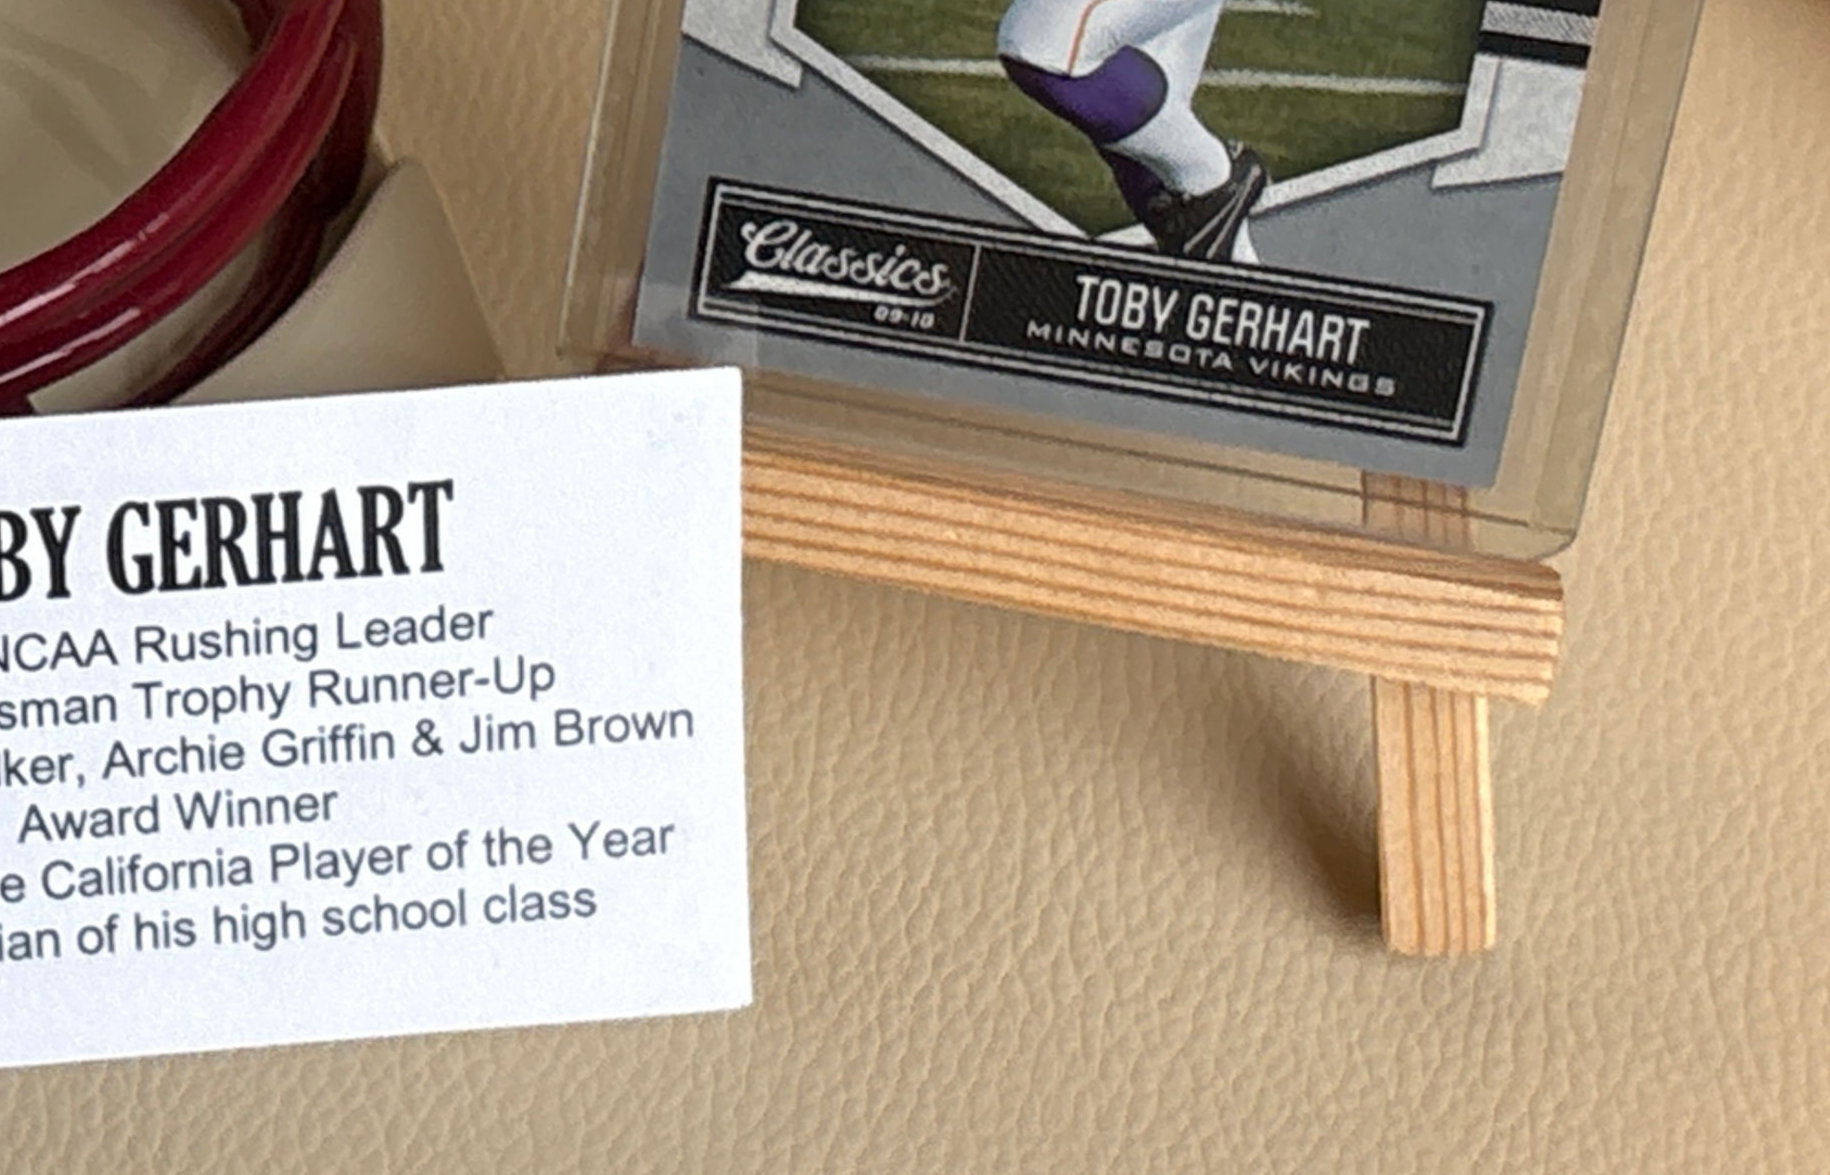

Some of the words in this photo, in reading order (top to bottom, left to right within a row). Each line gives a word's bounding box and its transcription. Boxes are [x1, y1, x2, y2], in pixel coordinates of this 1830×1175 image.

[740, 219, 950, 295] Classics
[872, 304, 936, 329] 09-10
[1075, 274, 1179, 335] TOBY
[1185, 292, 1371, 367] GERHART
[1026, 319, 1234, 372] MINNESOTA
[1247, 355, 1398, 398] VIKINGS
[106, 478, 455, 596] GERHART
[134, 618, 318, 664] Rushing
[337, 605, 494, 649] Leader
[132, 675, 291, 724] Trophy
[309, 655, 555, 708] Runner-Up
[102, 733, 245, 779] Archie
[262, 721, 395, 767] Griffin
[412, 718, 444, 757] &
[459, 713, 536, 754] Jim
[555, 708, 693, 747] Brown
[18, 795, 160, 844] Award
[174, 789, 338, 831] Winner
[41, 848, 253, 900] California
[270, 842, 412, 887] Player
[427, 830, 468, 871] of
[483, 828, 552, 867] the
[569, 821, 674, 859] Year
[77, 913, 119, 955] of
[134, 910, 197, 951] his
[213, 901, 306, 951] high
[323, 889, 466, 936] school
[484, 884, 597, 924] class
